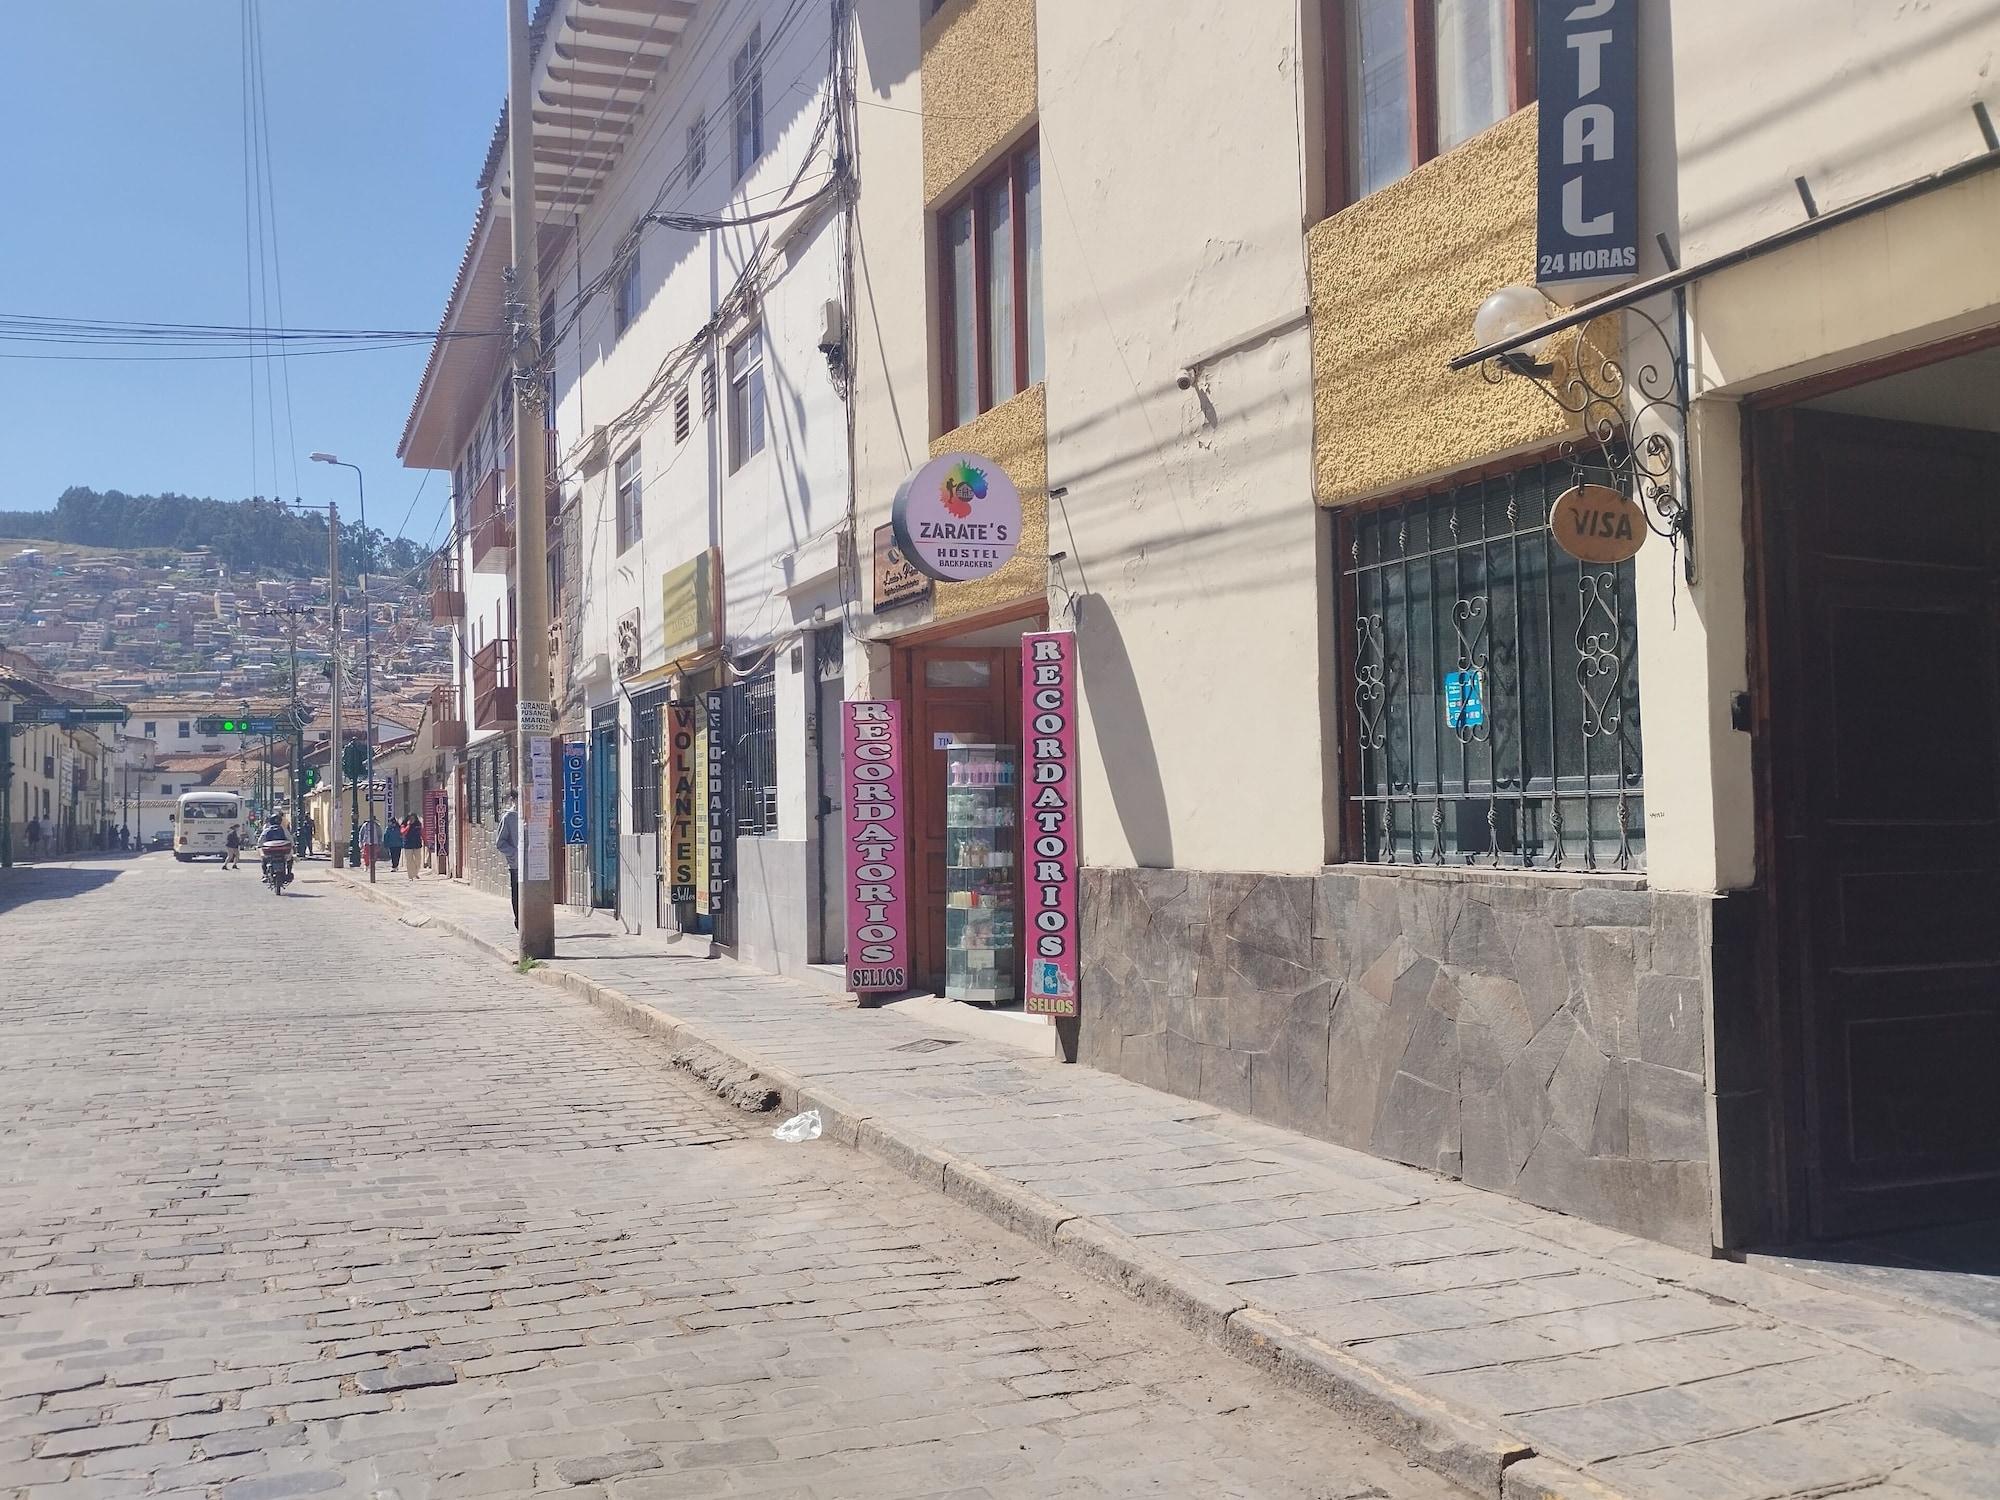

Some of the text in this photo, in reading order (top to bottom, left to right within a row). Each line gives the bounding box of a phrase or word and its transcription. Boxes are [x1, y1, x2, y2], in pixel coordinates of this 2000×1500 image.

[1540, 247, 1636, 275] 24 HORAS
[920, 522, 1008, 541] ZARATE'S
[1568, 507, 1633, 541] VISA
[937, 548, 999, 559] HOSTEL
[939, 560, 993, 568] BACKPACKERS
[569, 757, 584, 842] OPTICA
[674, 709, 692, 882] VOLANTES
[708, 696, 722, 910] RECORDATORIOS
[1032, 640, 1067, 957] RECORDATORIOS
[436, 797, 447, 856] IMPRENTA
[852, 702, 898, 964] RECORDATORIOS
[852, 967, 904, 988] SELLOS
[1029, 997, 1074, 1013] SELLOS
